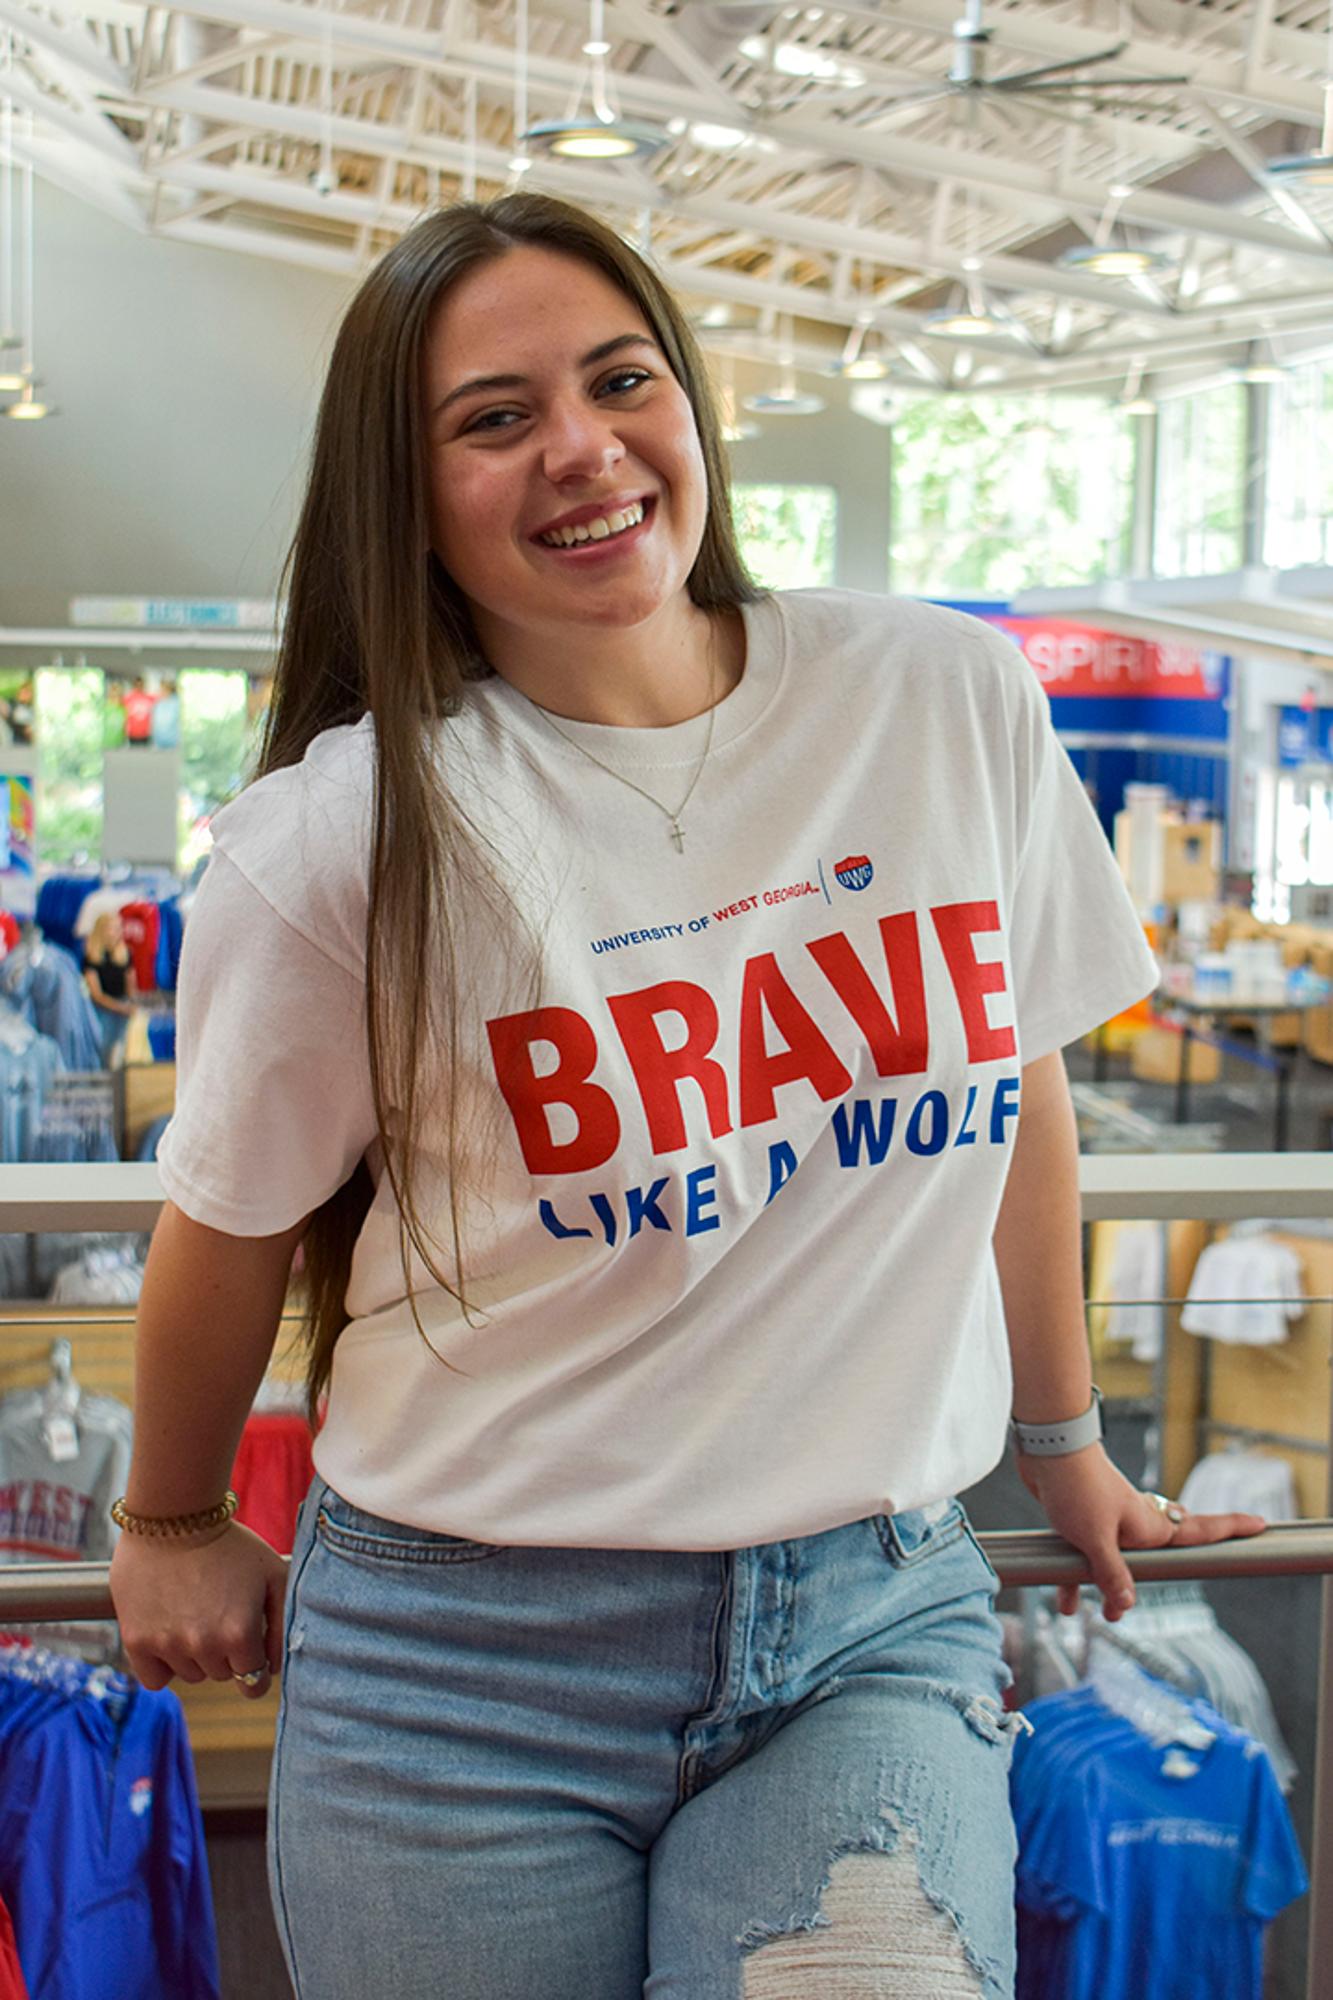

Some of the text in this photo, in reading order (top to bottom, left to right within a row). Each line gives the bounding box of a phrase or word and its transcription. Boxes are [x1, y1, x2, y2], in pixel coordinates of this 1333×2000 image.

[591, 924, 684, 954] UNIVERSITY
[688, 916, 711, 933] OF
[713, 896, 758, 922] WEST
[838, 865, 872, 888] UWG
[486, 900, 1017, 1175] BRAVE
[539, 1164, 721, 1247] LIKE
[831, 1077, 1019, 1168] WOLF
